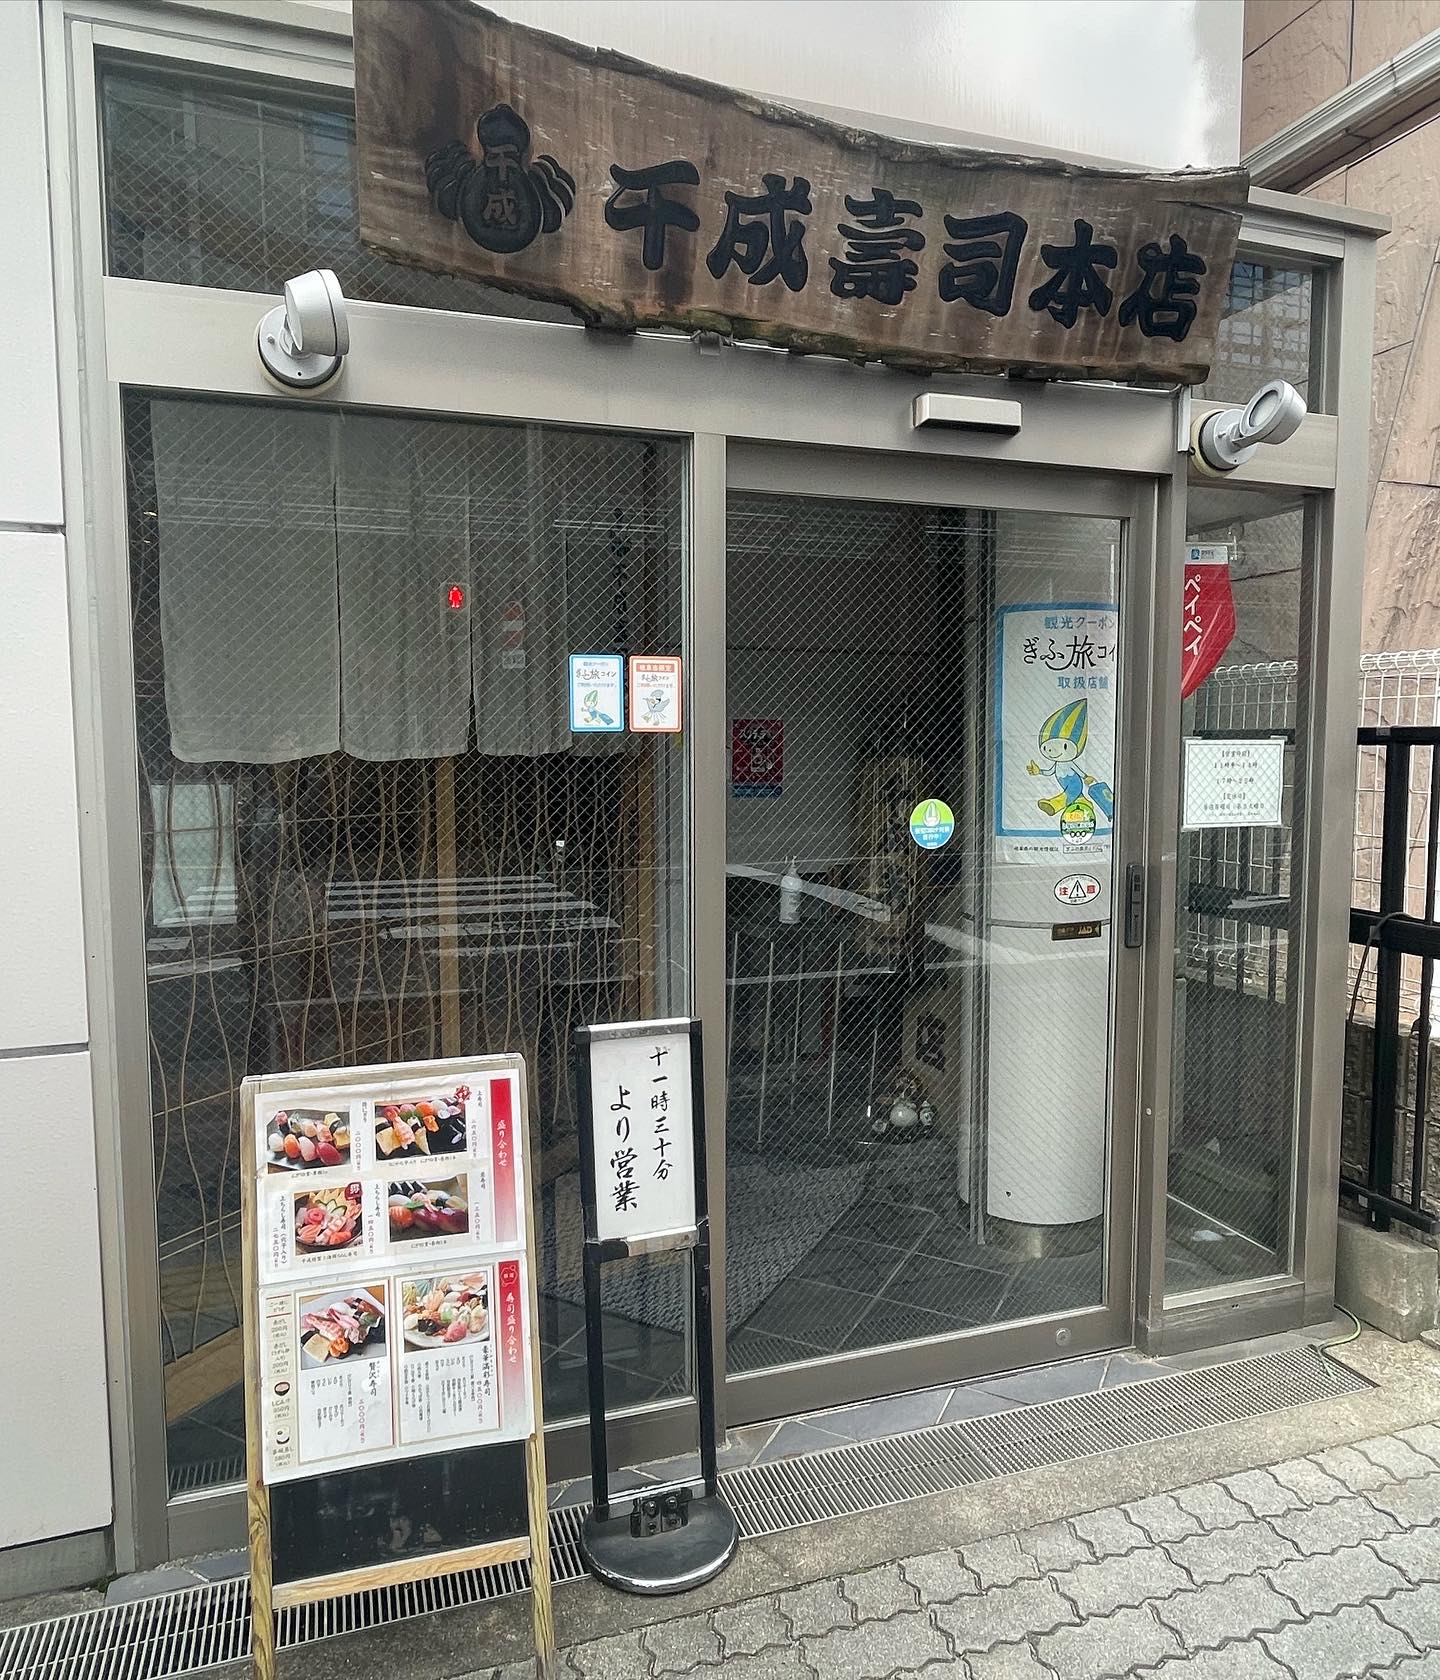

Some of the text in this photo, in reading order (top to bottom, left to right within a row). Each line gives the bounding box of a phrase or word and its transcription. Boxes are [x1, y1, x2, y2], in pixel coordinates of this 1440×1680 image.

[604, 158, 1207, 342] 千成壽司本店
[1183, 573, 1203, 656] ペイペイ
[576, 668, 617, 681] ぎふ旅コイン
[496, 1119, 508, 1167] 盛り合わせ
[610, 1085, 640, 1212] より営業
[649, 1046, 673, 1181] 十一時三十分
[505, 1291, 518, 1363] 寿司盛り合わせ
